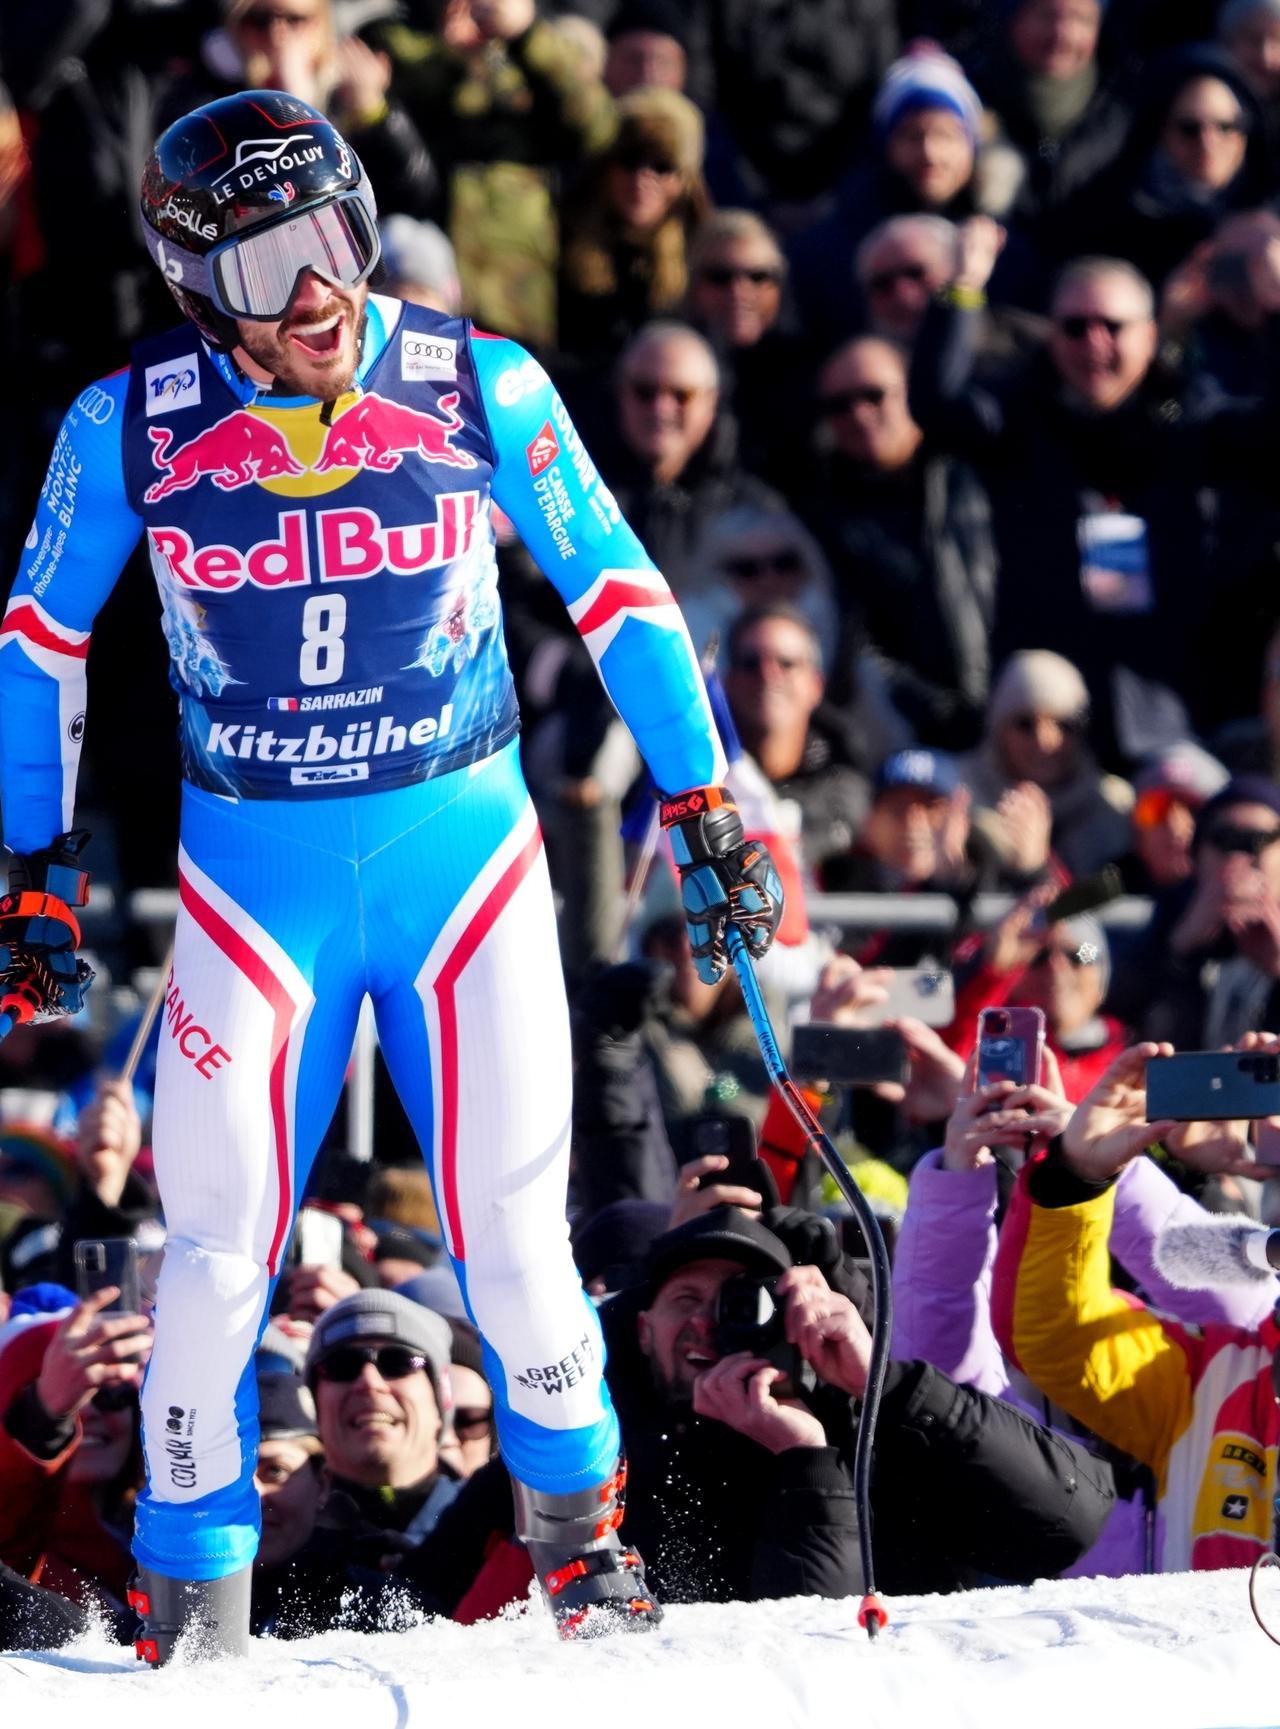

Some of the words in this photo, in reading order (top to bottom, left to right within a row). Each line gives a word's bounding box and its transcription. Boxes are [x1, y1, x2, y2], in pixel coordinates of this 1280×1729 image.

[213, 185, 235, 205] LE
[239, 146, 324, 190] DEVOLUY
[164, 196, 218, 241] bollé
[47, 451, 69, 514] MONT
[58, 454, 82, 528] BLANC
[546, 466, 576, 523] CAISSE
[32, 530, 67, 597] Rhône-Alpes
[147, 509, 308, 592] Red
[316, 490, 480, 582] Bull
[300, 593, 347, 686] 8
[300, 686, 384, 712] SARRAZIN
[206, 704, 454, 763] Kitzbühel
[526, 1331, 589, 1381] GREEN
